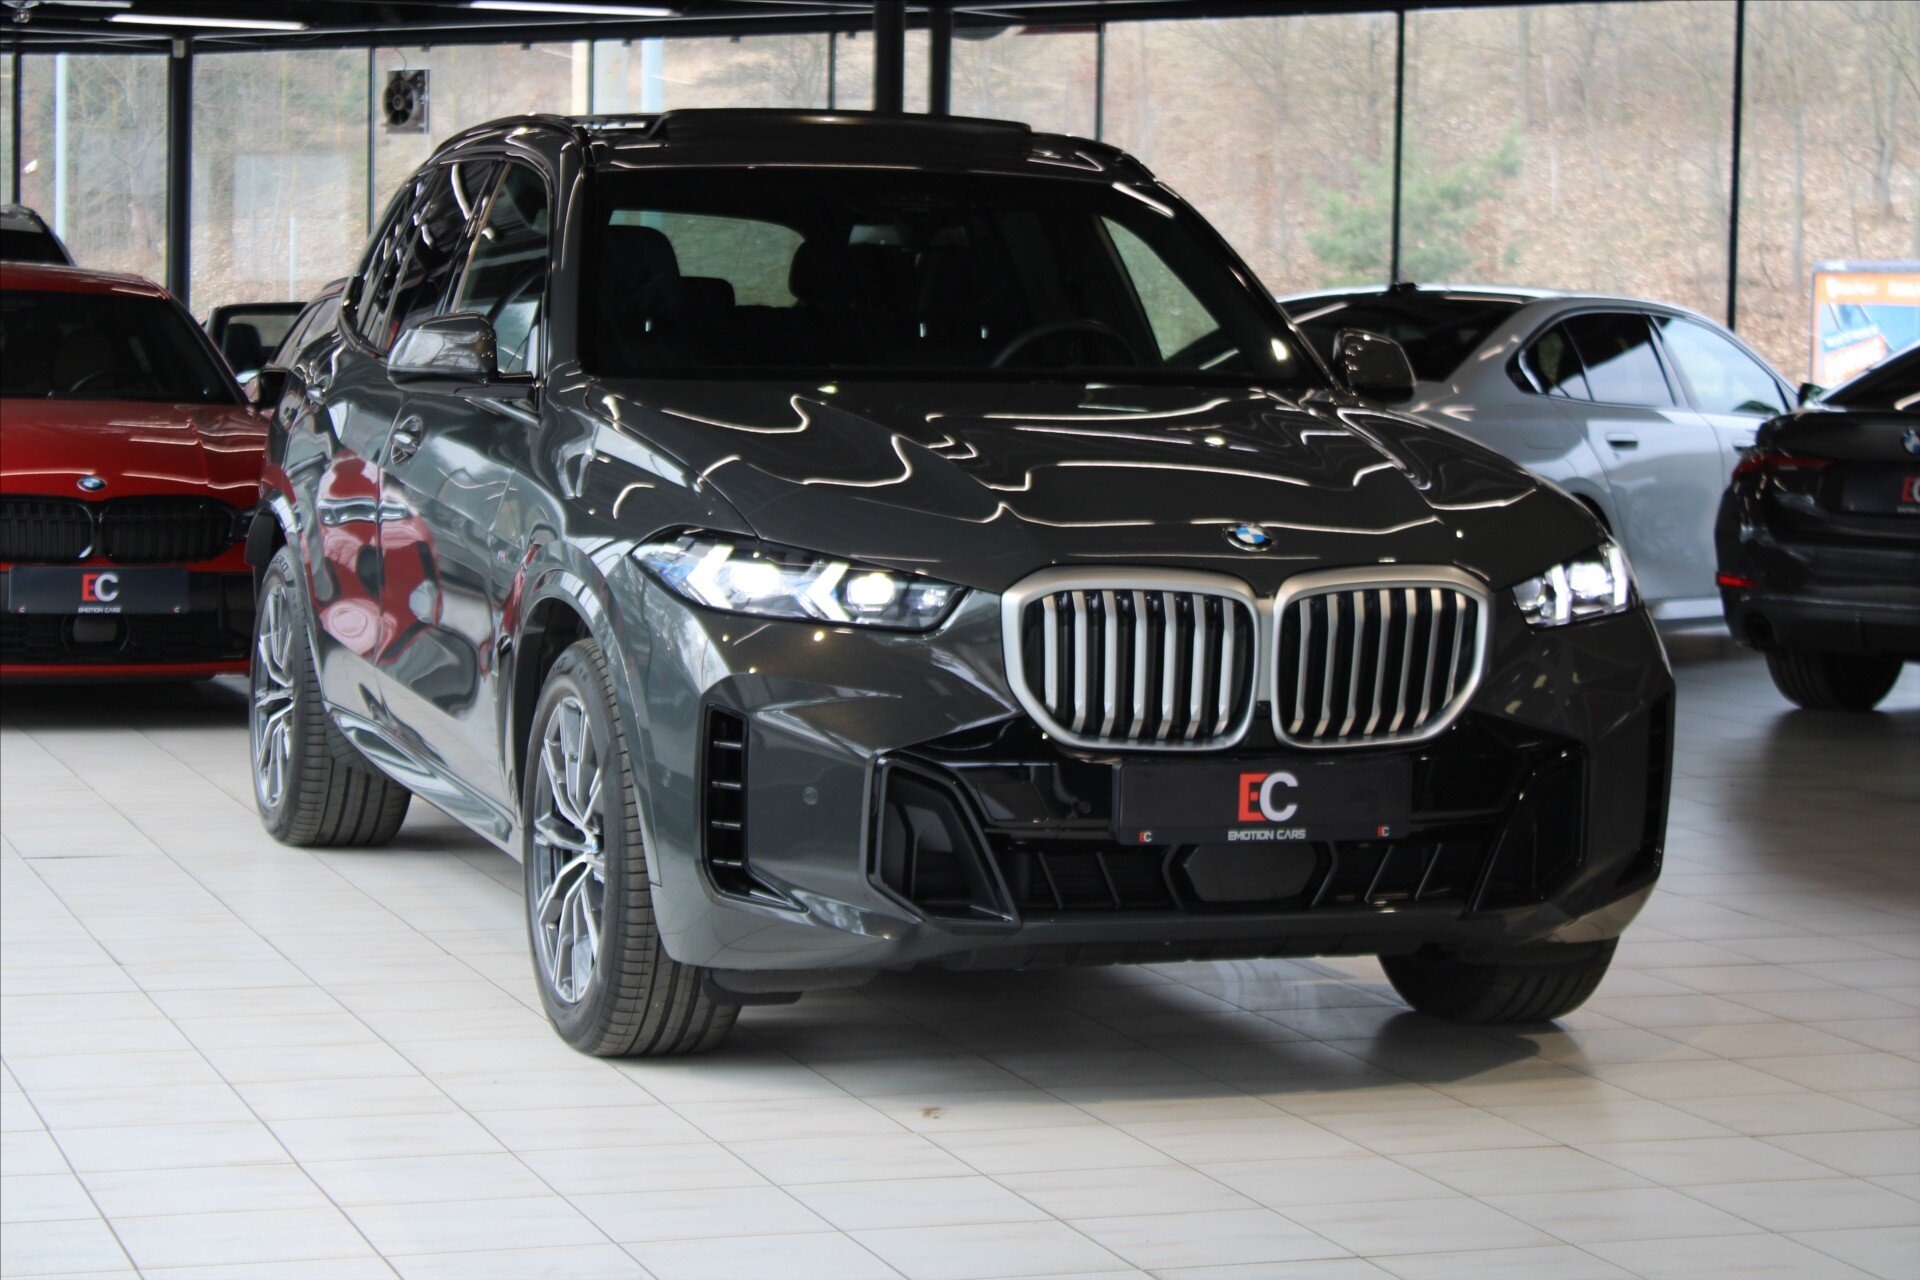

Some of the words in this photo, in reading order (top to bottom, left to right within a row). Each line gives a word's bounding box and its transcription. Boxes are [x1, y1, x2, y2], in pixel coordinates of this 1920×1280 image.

[82, 573, 119, 602] EC
[1238, 771, 1299, 822] EC
[1227, 830, 1275, 841] EMOTION
[1276, 829, 1307, 840] CARS
